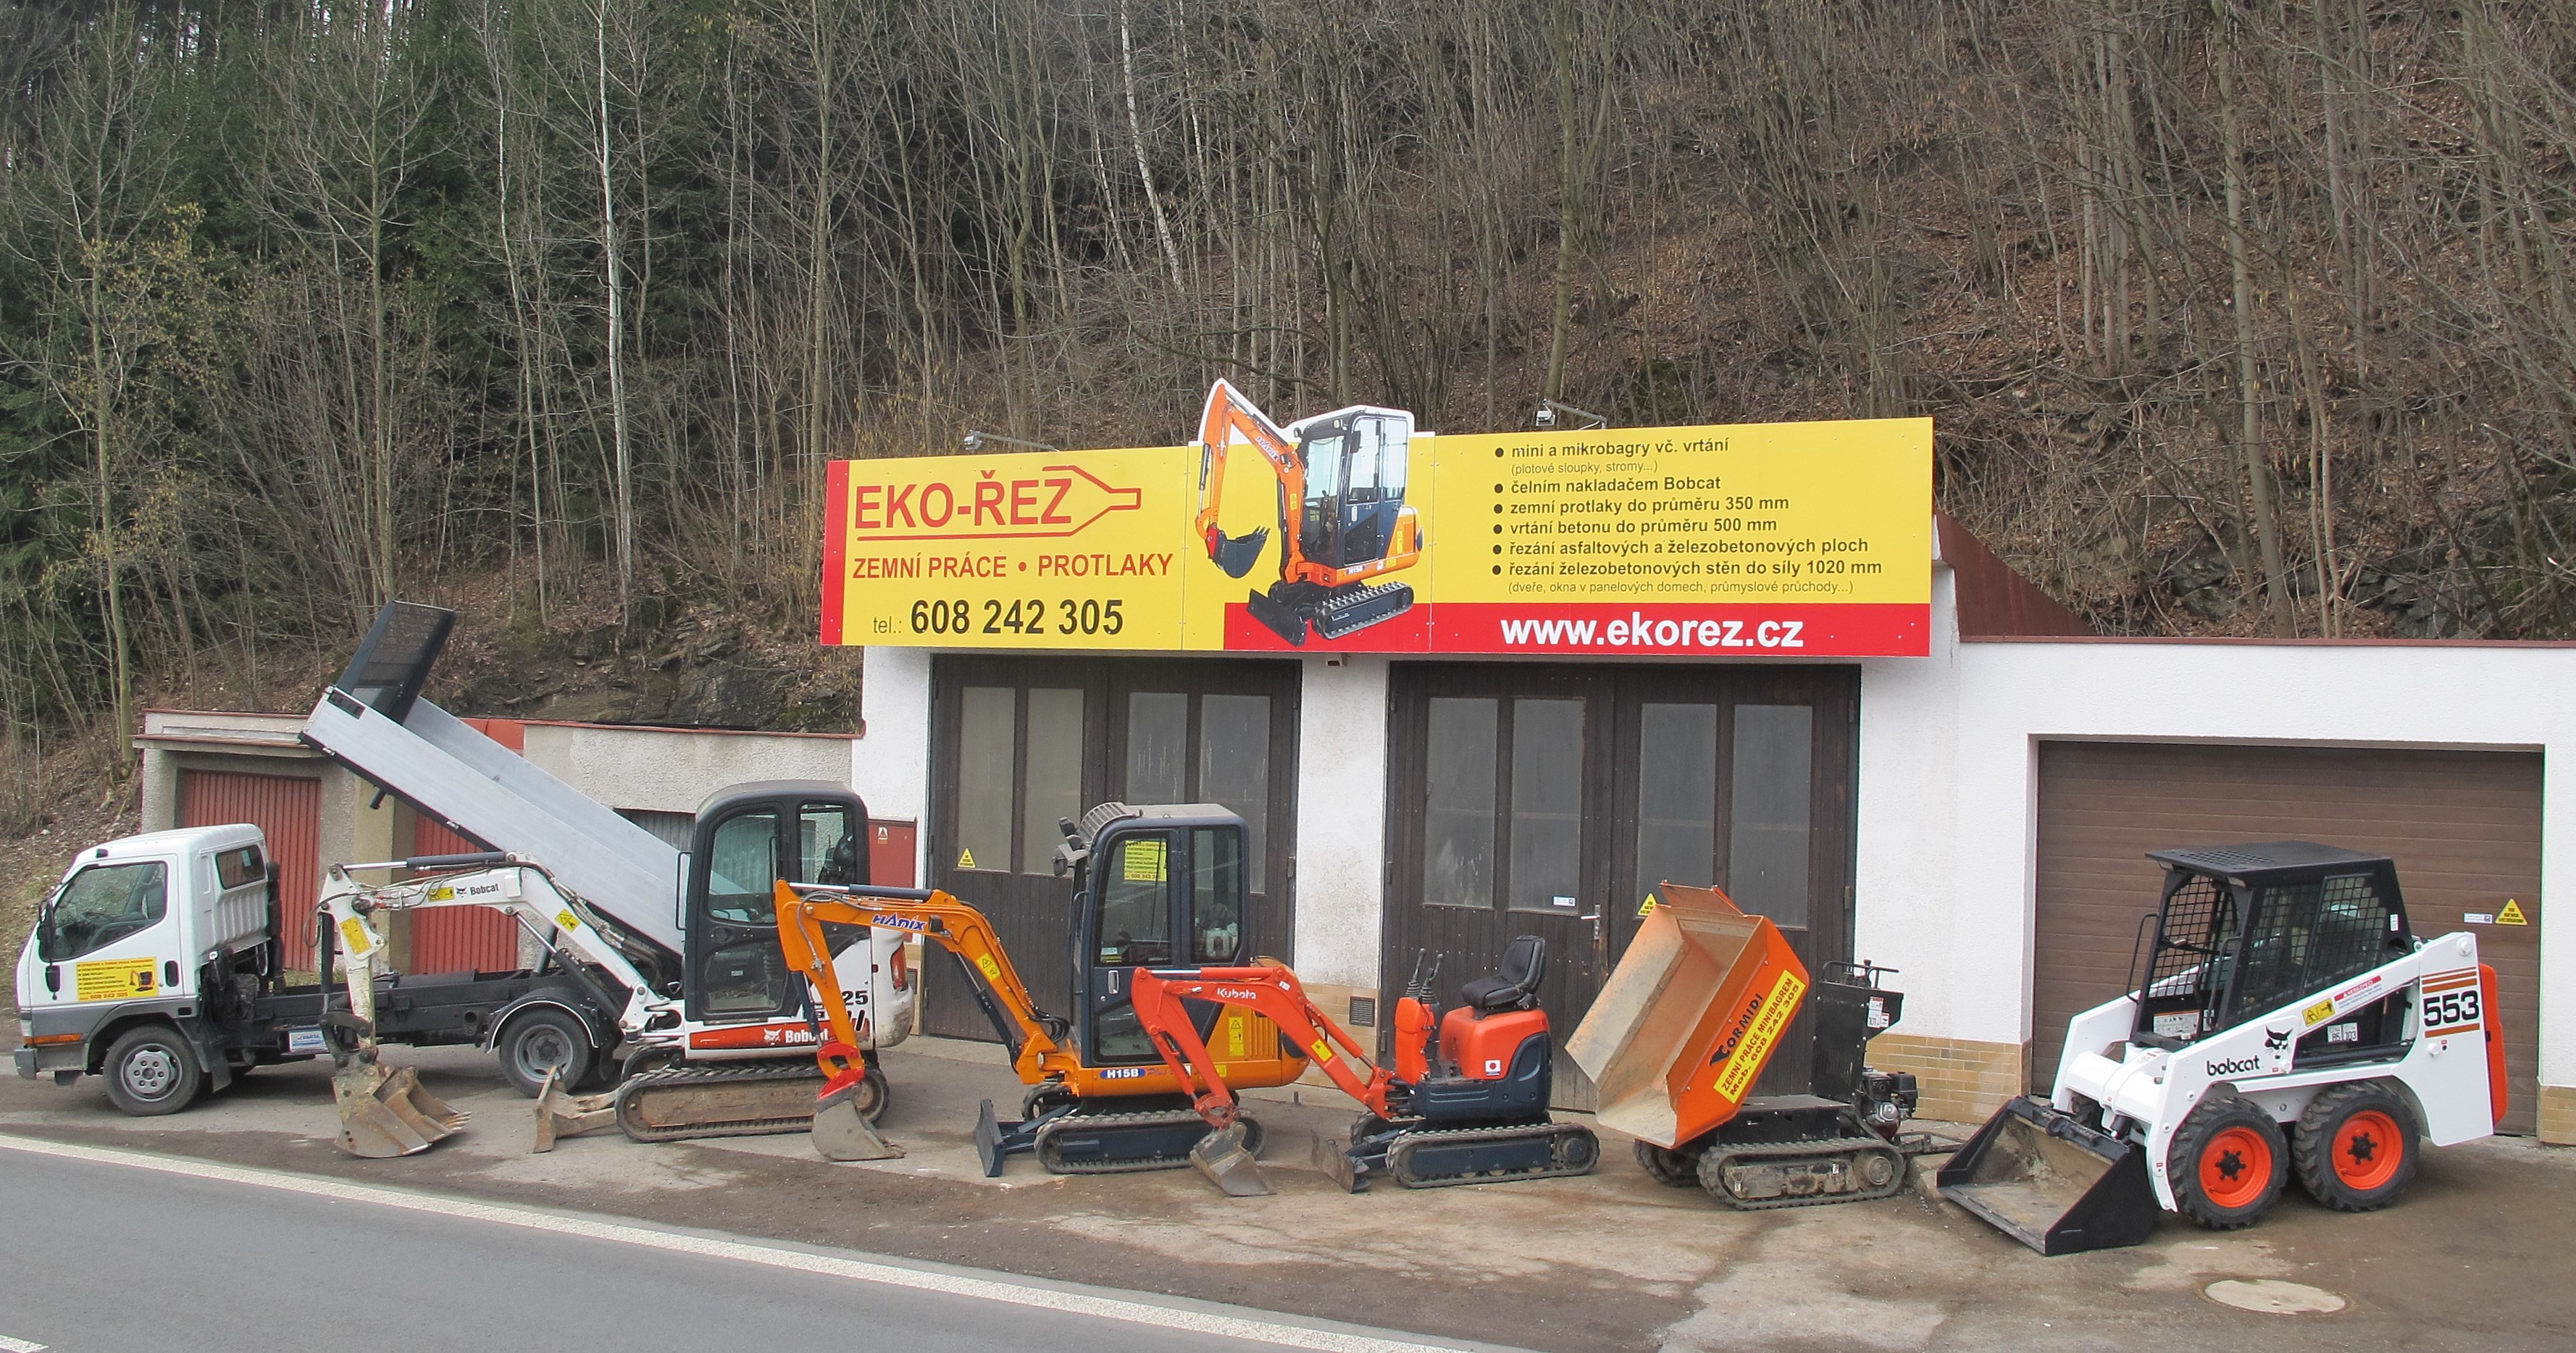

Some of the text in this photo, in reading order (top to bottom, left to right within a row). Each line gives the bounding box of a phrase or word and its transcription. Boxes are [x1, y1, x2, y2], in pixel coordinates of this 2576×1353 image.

[1511, 437, 1730, 458] mini a mikrobagry vč. vrtání
[1511, 460, 1659, 477] (plotové sloupky, stromy...)
[1511, 477, 1721, 494] čelním nakladačem Bobcat
[855, 470, 1072, 529] EKO-ŘEZ
[1510, 496, 1789, 516] zemní protlaky do průměru 350 mm
[1510, 518, 1777, 536] vrtání betonu do průměru 500 mm
[1510, 538, 1869, 557] řezání asfaltových a železobetonových ploch
[853, 551, 1174, 579] ZEMNÍ PRÁCE PROTLAKY
[1509, 560, 1882, 578] řezání železobetonových stěn do síly 1020 mm
[1508, 580, 1854, 595] (dveře, okna v panelových domech, průmyslové průchody...)
[873, 599, 1124, 635] tel.: 608 242 305
[1500, 612, 1805, 648] www.ekorez.cz
[469, 883, 500, 896] Bobcat
[1217, 988, 1256, 1000] Kubota
[2423, 990, 2480, 1027] 553
[1709, 993, 1764, 1066] CORMIDI
[1750, 1038, 1768, 1062] 608
[1767, 1010, 1784, 1036] 242
[1783, 985, 1799, 1009] 305
[1722, 978, 1794, 1092] ZEMNÍ PRÁCE MINIBAGREM
[1107, 1068, 1139, 1078] H15B
[2207, 1055, 2260, 1077] bobcat
